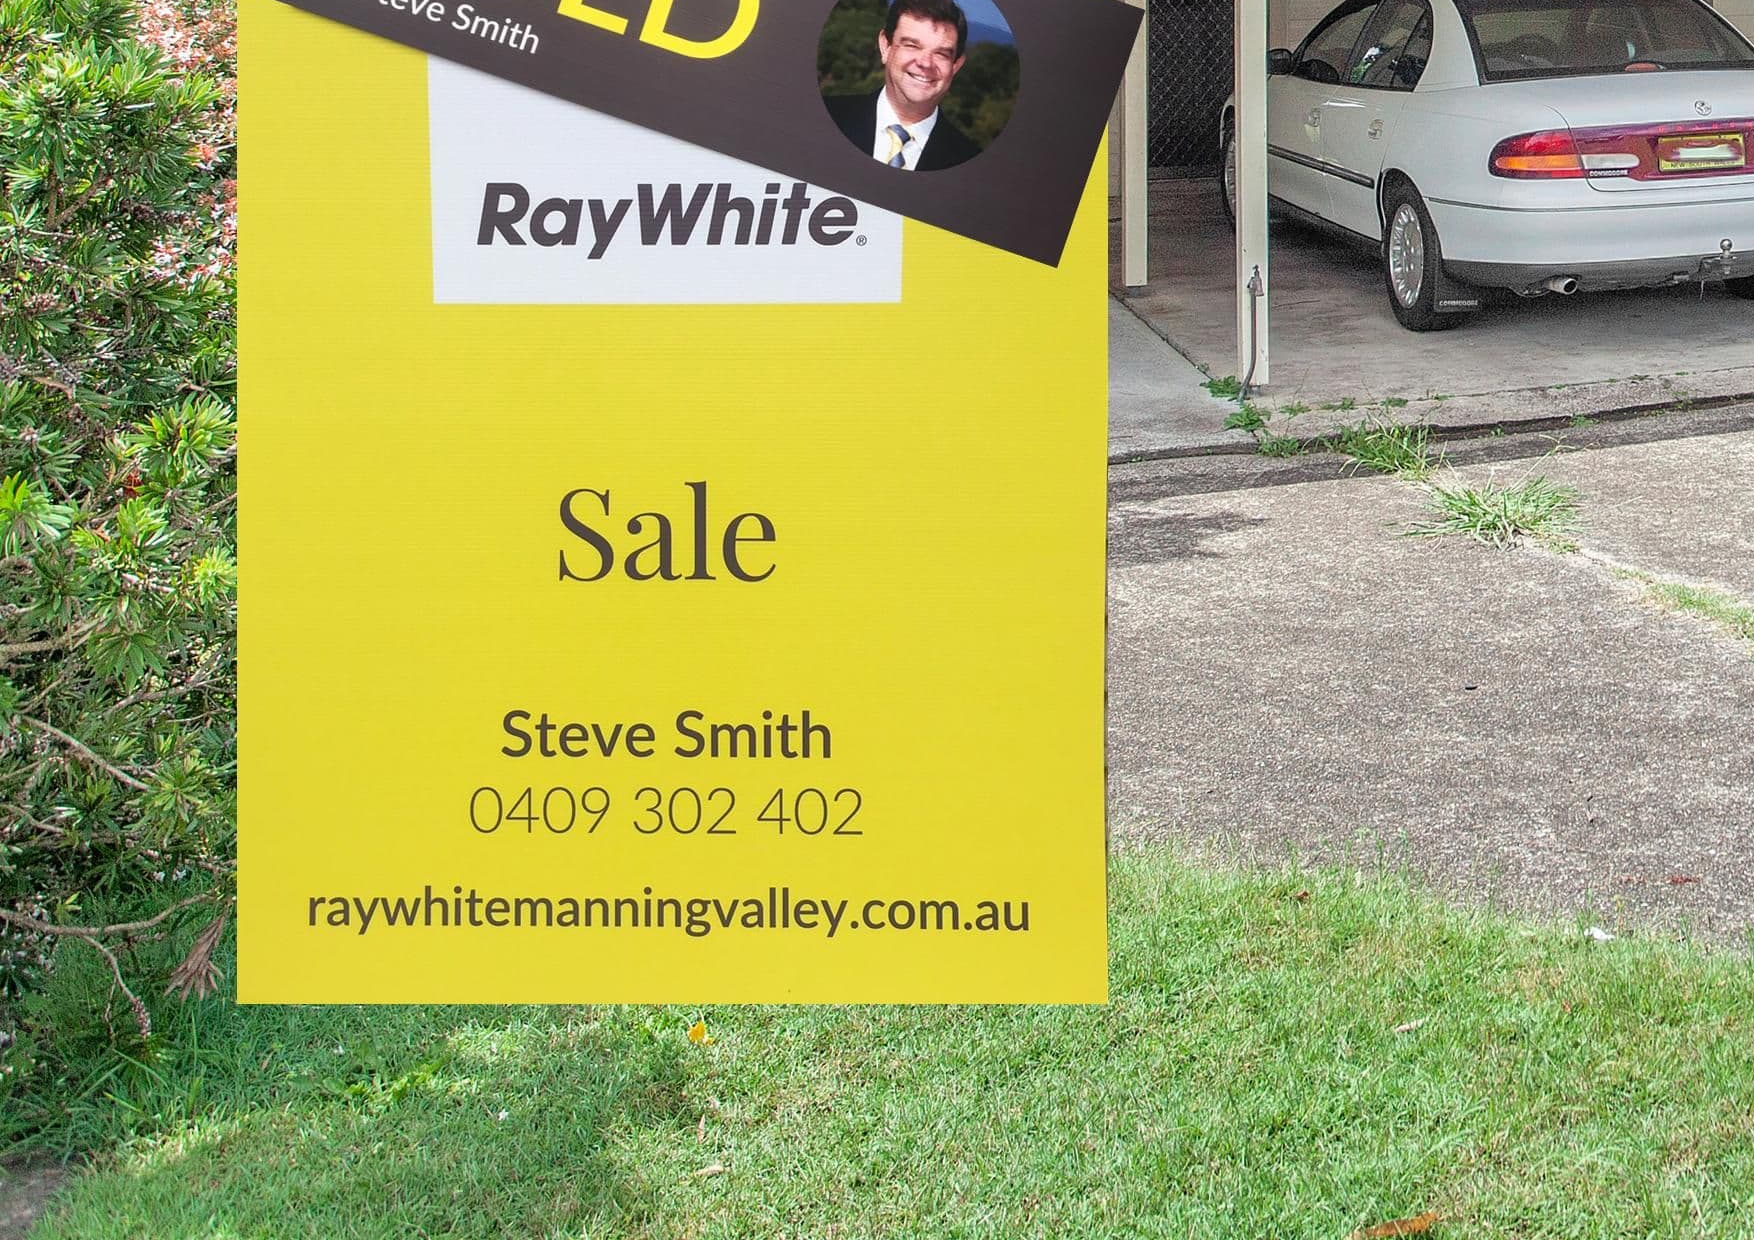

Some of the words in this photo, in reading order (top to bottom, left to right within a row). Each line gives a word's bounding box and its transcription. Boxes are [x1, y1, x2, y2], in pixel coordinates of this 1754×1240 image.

[451, 3, 540, 55] Smith
[559, 480, 776, 583] Sale
[501, 709, 656, 758] Steve
[674, 710, 831, 759] Smith
[469, 786, 610, 834] 0409
[633, 787, 737, 835] 302
[756, 788, 863, 836] 402
[307, 885, 1030, 938] raywhitemanningvalley.com.au
